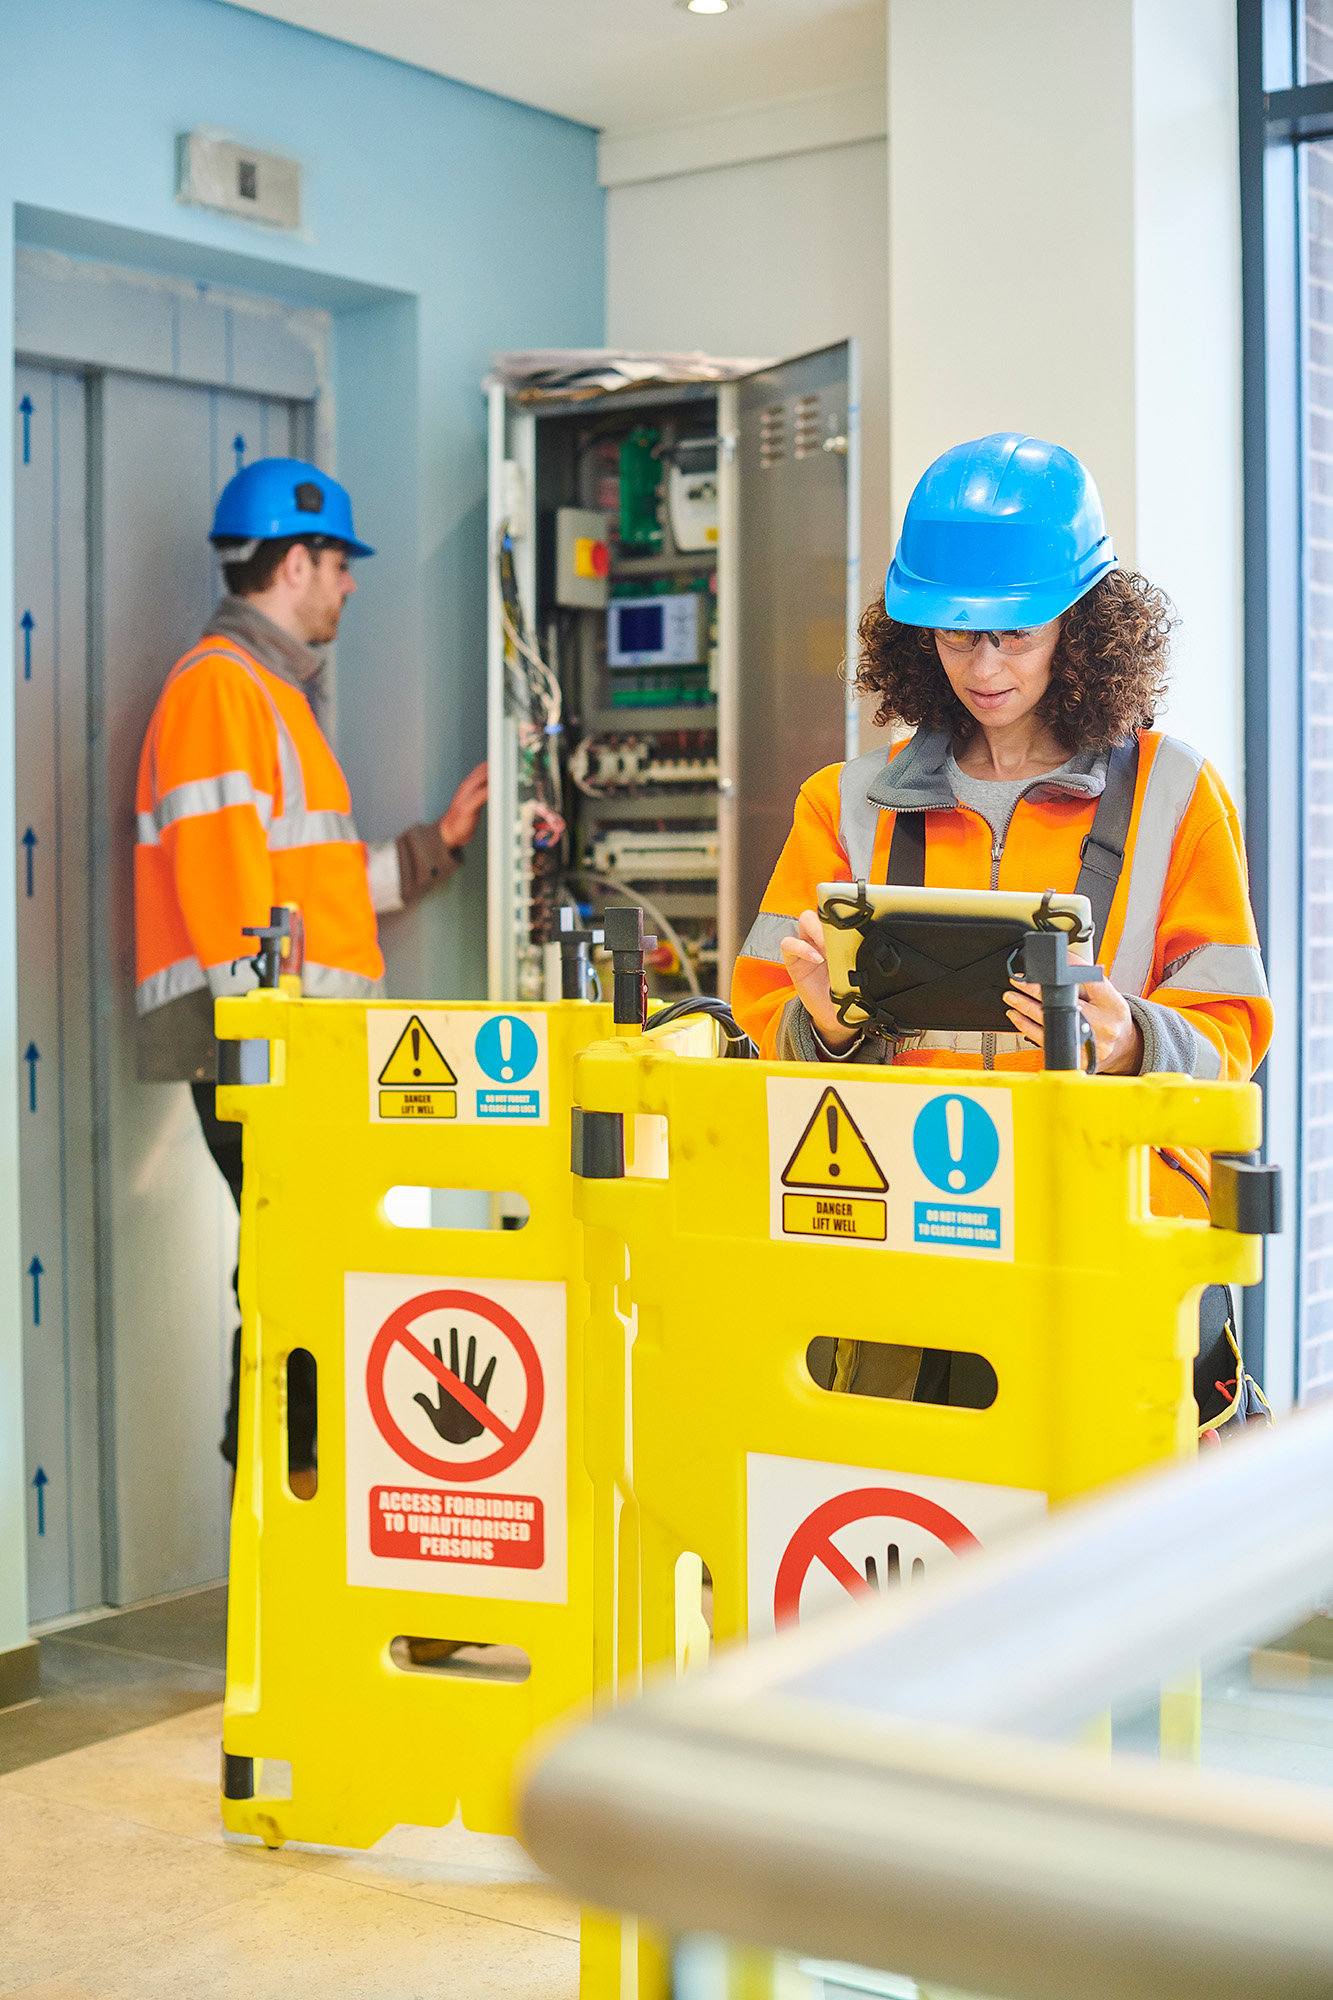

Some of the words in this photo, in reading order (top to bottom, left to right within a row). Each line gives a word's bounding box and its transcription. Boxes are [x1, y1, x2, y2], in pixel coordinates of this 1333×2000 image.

[404, 1095, 431, 1103] DANGER
[401, 1106, 415, 1114] LIFT
[417, 1106, 434, 1114] WELL
[816, 1201, 853, 1216] DANGER
[812, 1217, 830, 1230] LIFT
[833, 1218, 856, 1233] WELL
[918, 1223, 930, 1236] TO
[930, 1224, 956, 1238] CLOSE
[956, 1226, 974, 1239] AND
[974, 1227, 997, 1241] LOCK
[378, 1491, 443, 1515] ACCESS
[444, 1495, 535, 1521] FORBIDDEN
[383, 1512, 406, 1532] TO
[407, 1514, 531, 1542] UNAUTHORISED
[420, 1536, 495, 1560] PERSONS
